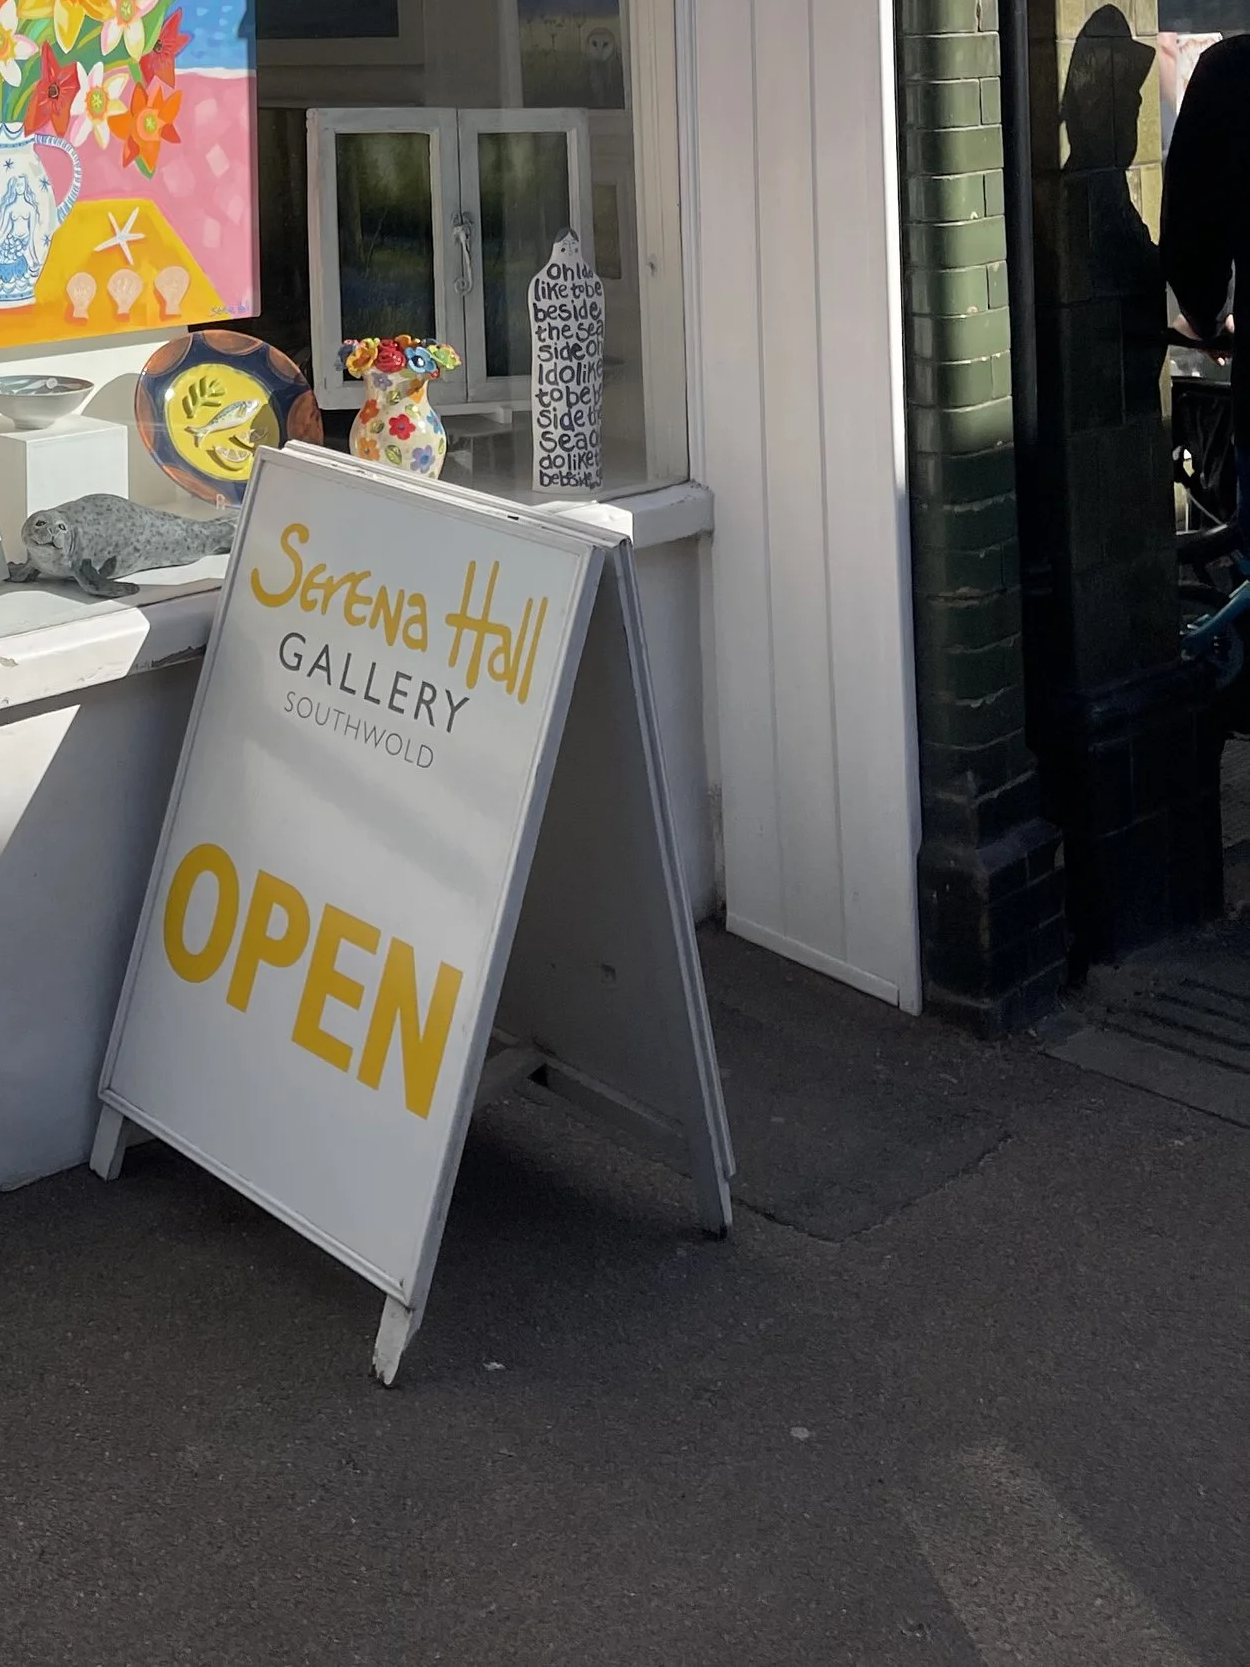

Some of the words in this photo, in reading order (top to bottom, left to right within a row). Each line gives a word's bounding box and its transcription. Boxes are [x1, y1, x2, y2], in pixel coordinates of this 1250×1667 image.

[534, 278, 568, 302] like
[532, 298, 602, 322] beside
[535, 322, 574, 342] the
[537, 341, 586, 362] side
[537, 406, 585, 432] side
[444, 560, 548, 705] Hall
[278, 632, 470, 733] GALLERY
[283, 690, 434, 769] SOUTHWOLD
[163, 843, 464, 1120] OPEN
